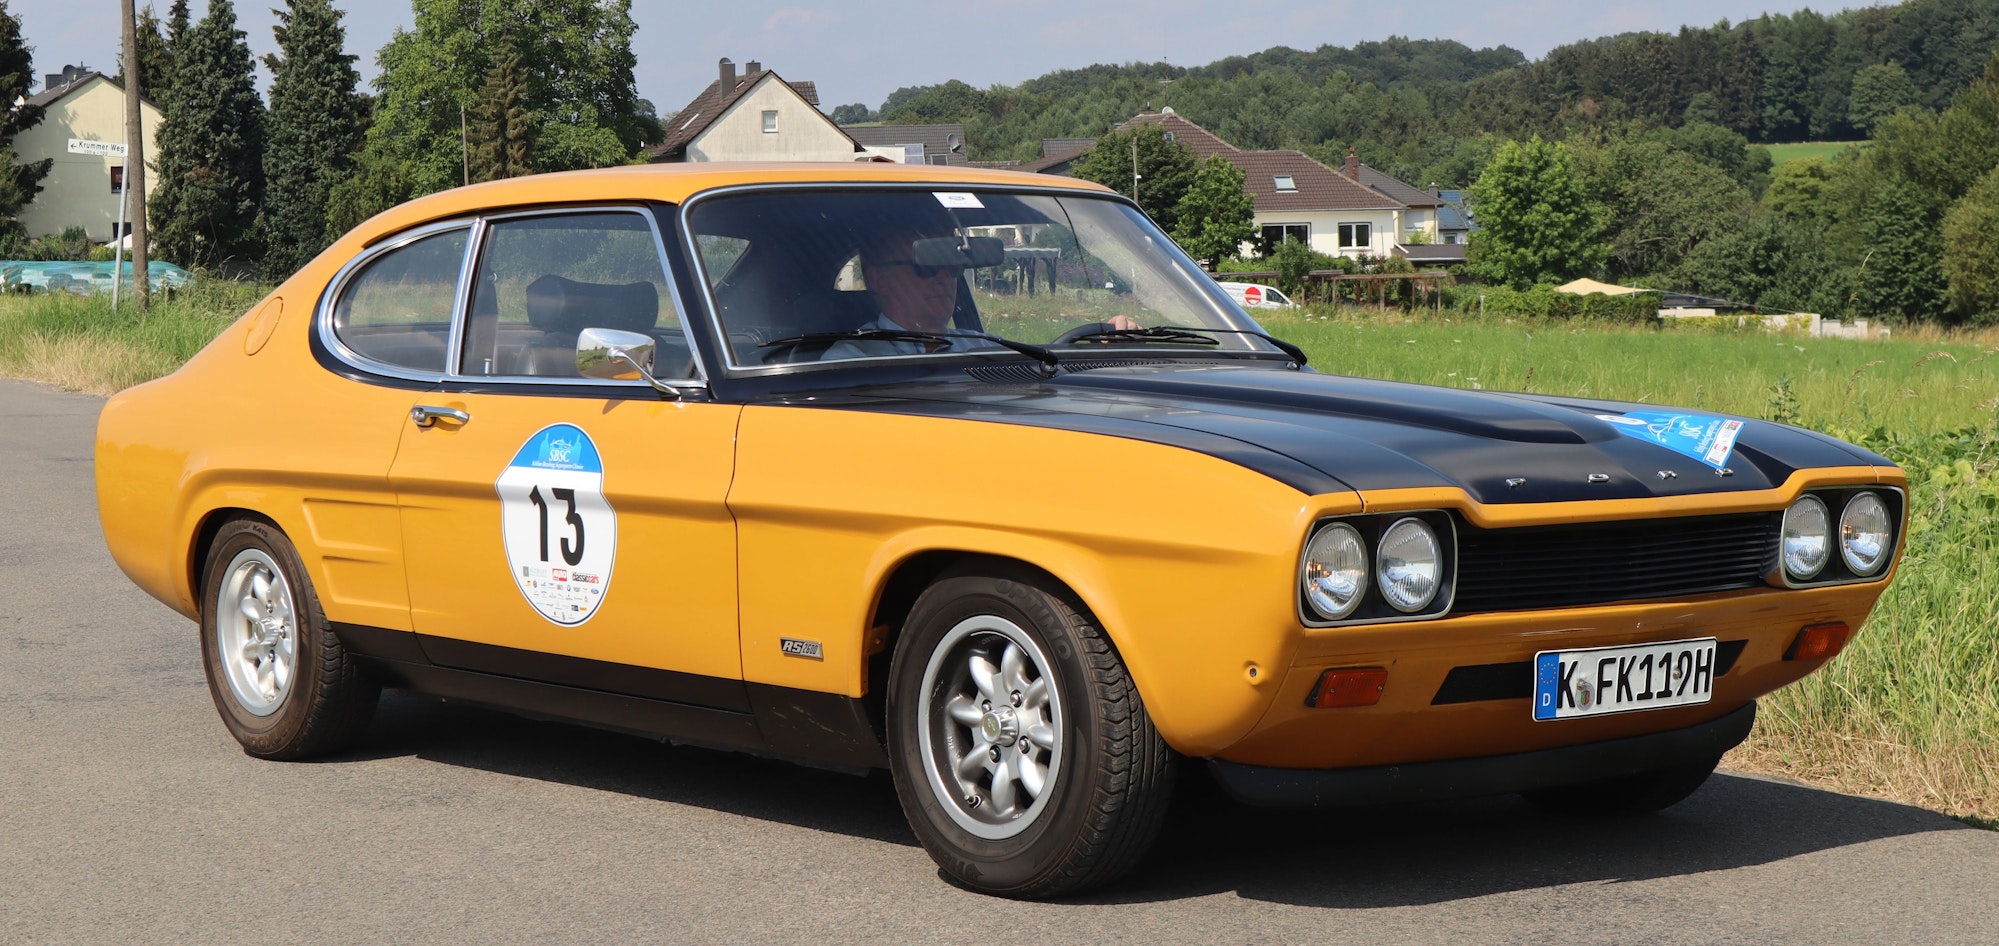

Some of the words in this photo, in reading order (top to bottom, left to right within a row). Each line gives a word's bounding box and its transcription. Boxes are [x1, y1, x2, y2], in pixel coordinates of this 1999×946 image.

[79, 141, 109, 150] Krummer
[110, 144, 125, 153] Weg
[548, 449, 571, 462] SBSC
[529, 485, 585, 566] 13
[1542, 692, 1551, 707] D
